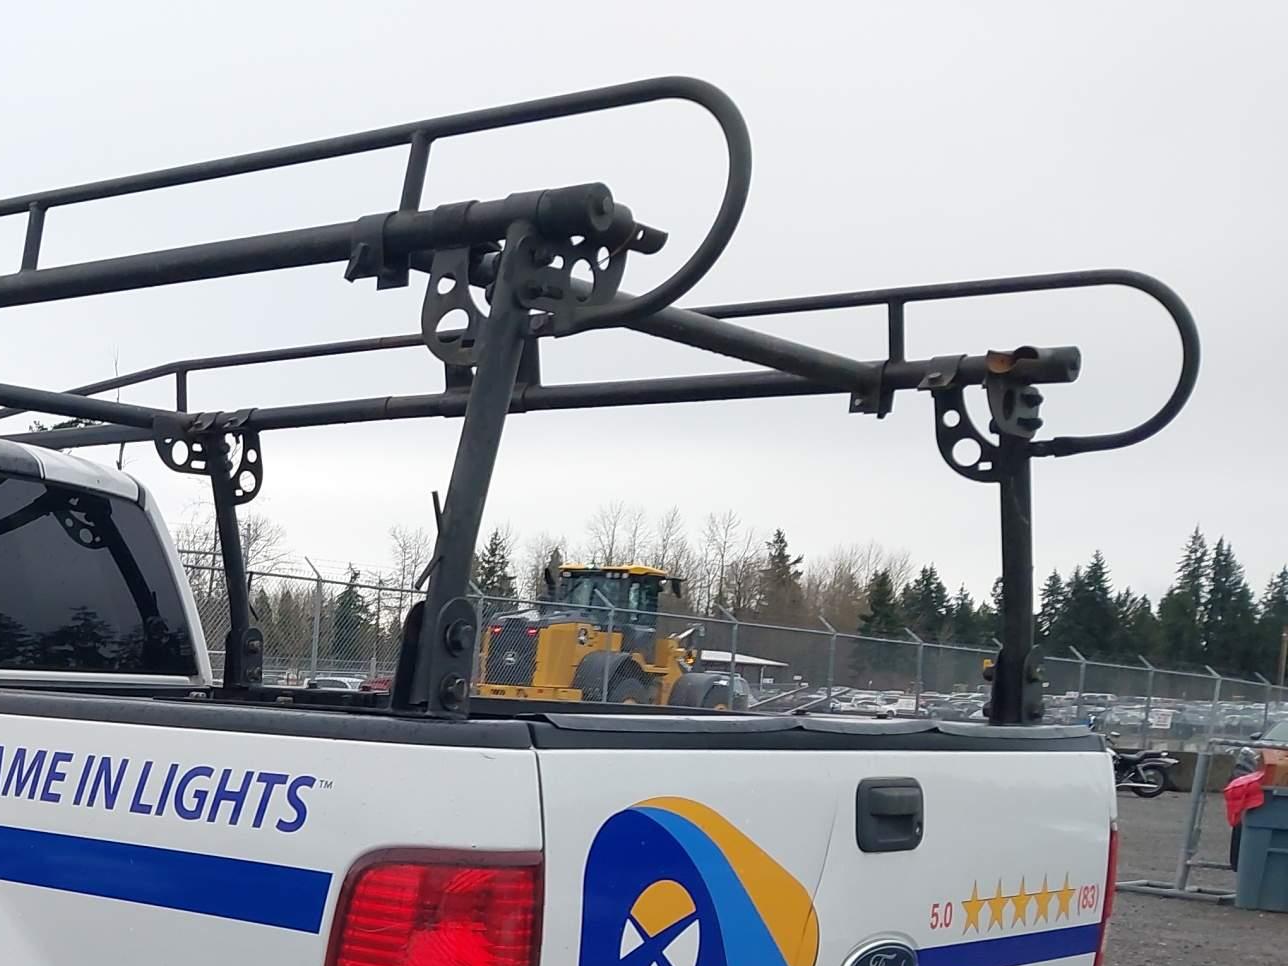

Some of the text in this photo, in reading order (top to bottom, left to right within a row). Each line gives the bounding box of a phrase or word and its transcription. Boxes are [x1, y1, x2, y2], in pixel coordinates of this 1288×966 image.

[72, 755, 130, 810] IN
[930, 884, 1100, 929] 5.0 (83)
